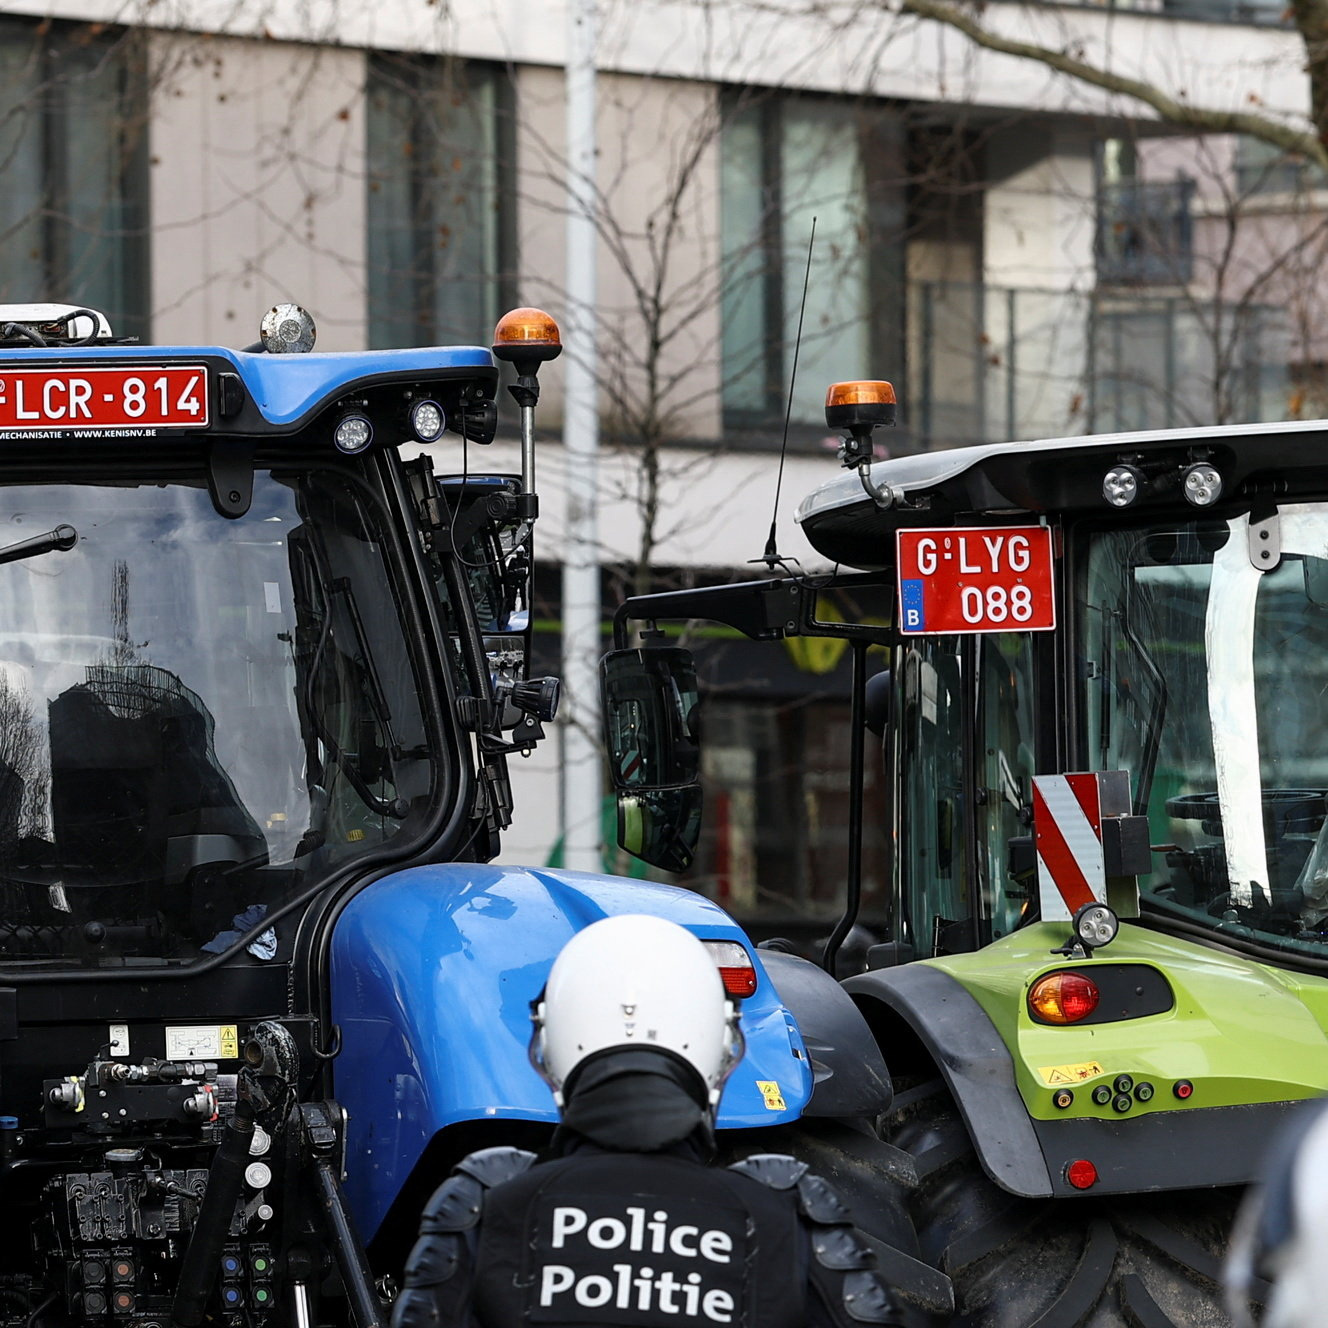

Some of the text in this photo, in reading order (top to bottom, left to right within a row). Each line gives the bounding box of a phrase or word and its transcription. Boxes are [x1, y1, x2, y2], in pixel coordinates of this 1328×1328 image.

[74, 429, 157, 439] WWW.KENISNV.BE
[907, 585, 1033, 626] B 088
[551, 1207, 733, 1264] Police
[539, 1264, 735, 1323] Politie
